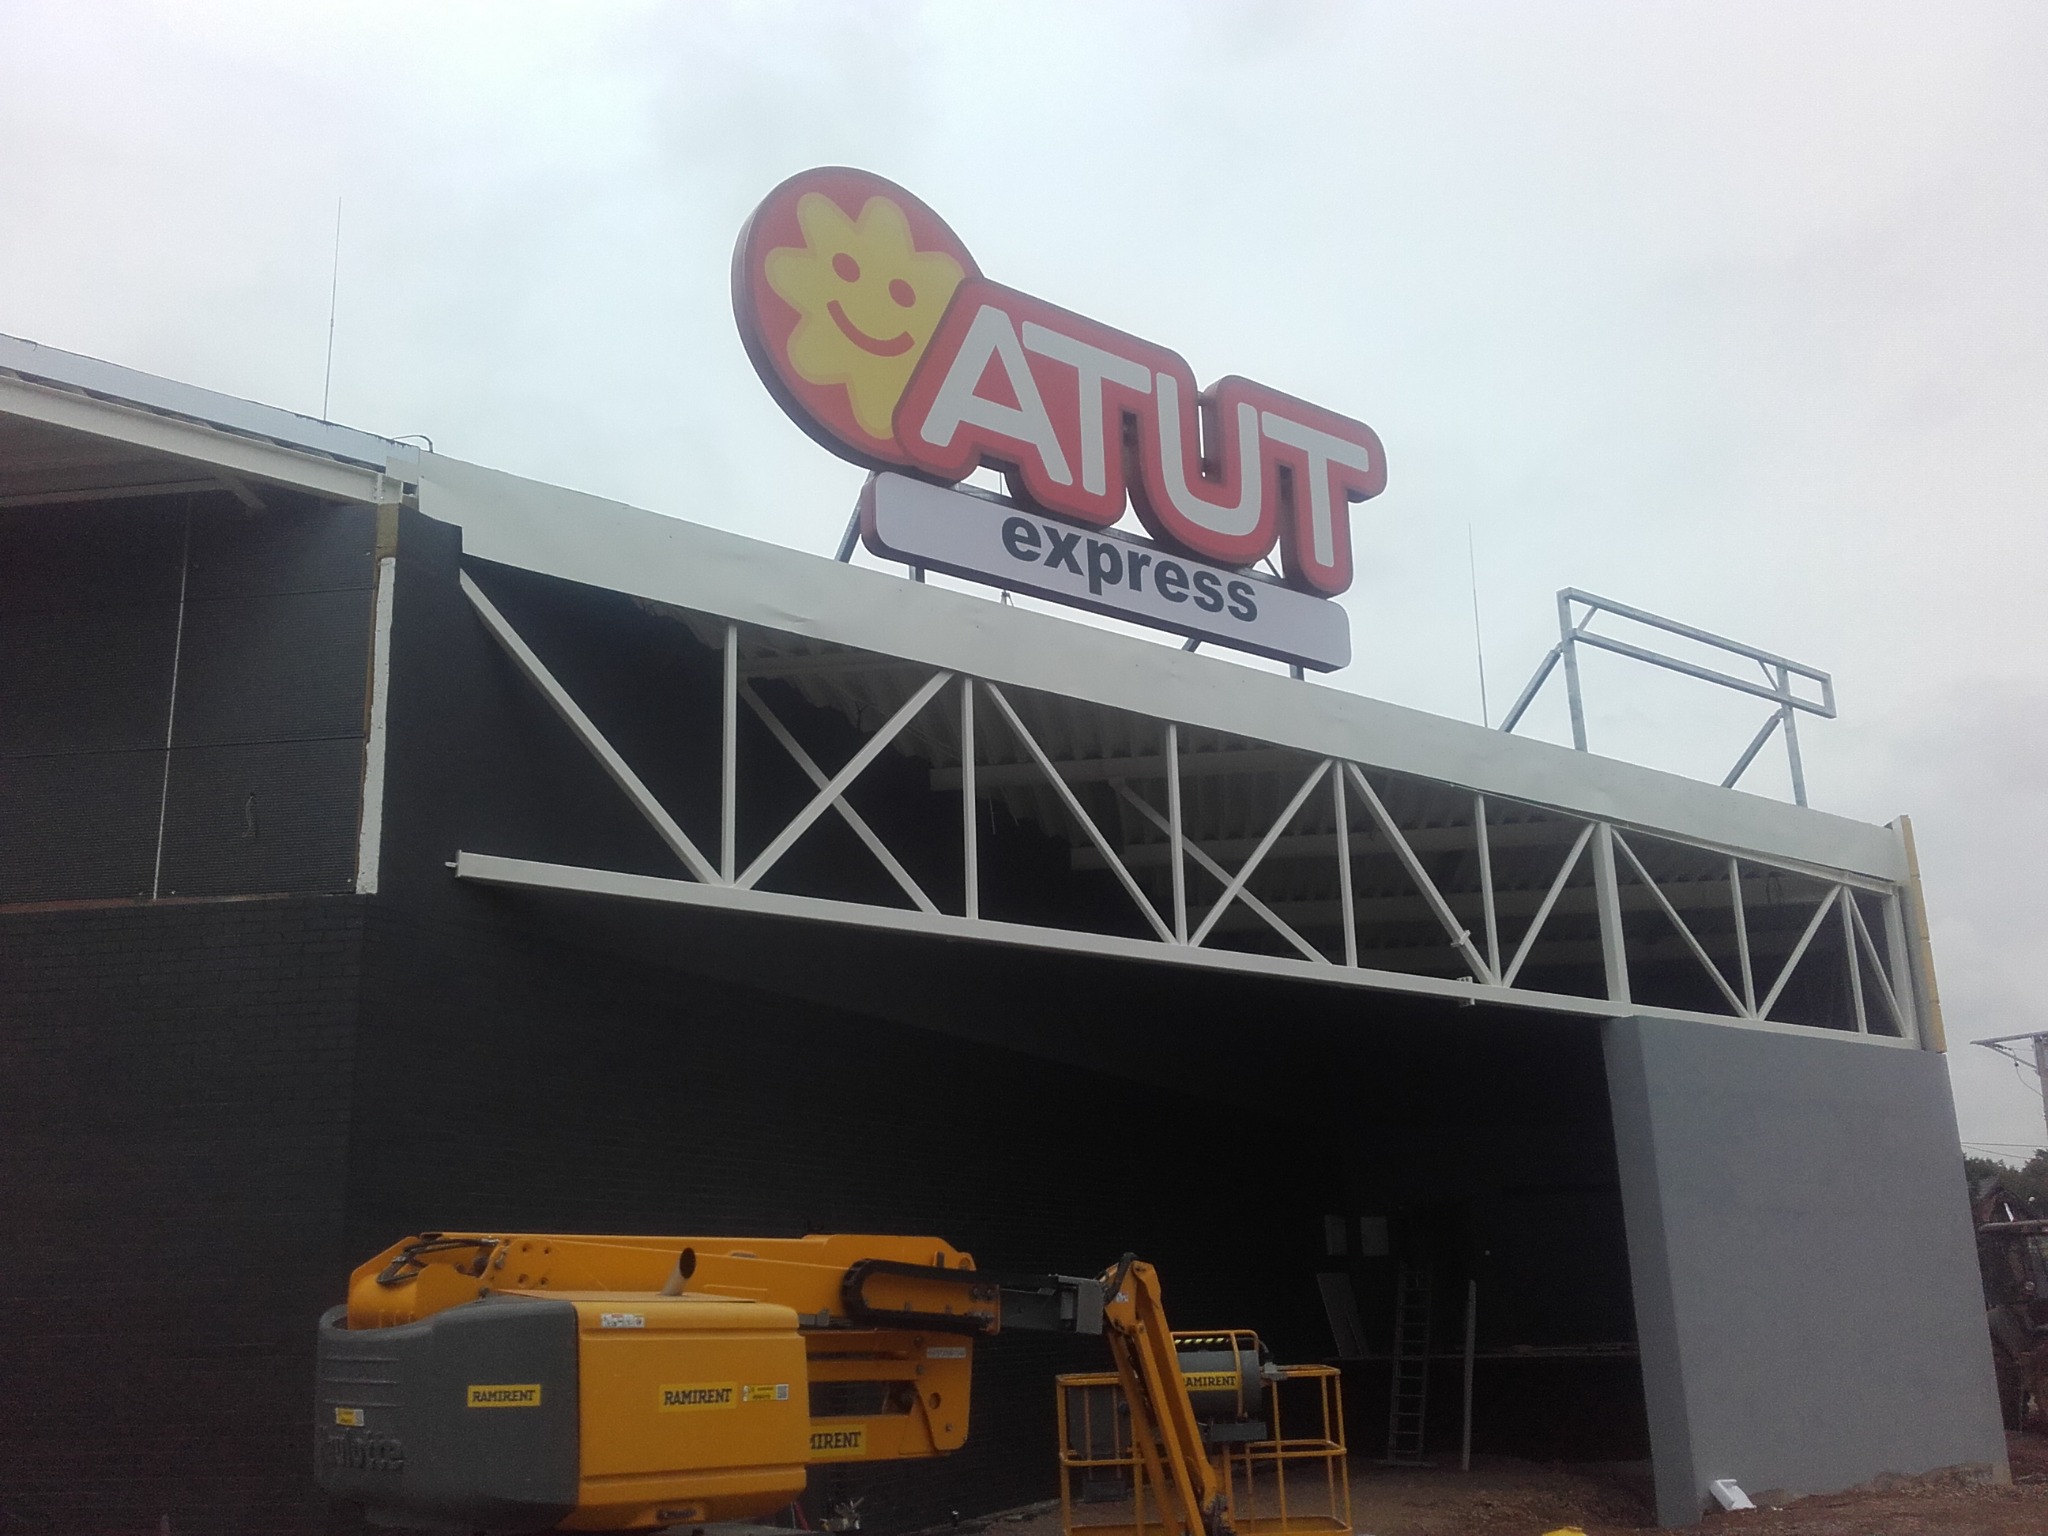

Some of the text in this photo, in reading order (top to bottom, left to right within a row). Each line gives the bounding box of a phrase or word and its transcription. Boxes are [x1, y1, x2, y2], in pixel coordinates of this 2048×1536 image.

[920, 304, 1369, 568] ATUT
[1001, 516, 1258, 622] express
[1184, 1375, 1236, 1387] AMIRENT
[472, 1390, 535, 1402] RAMIRENT
[664, 1388, 732, 1405] RAMIRENT
[809, 1431, 862, 1450] IRENT
